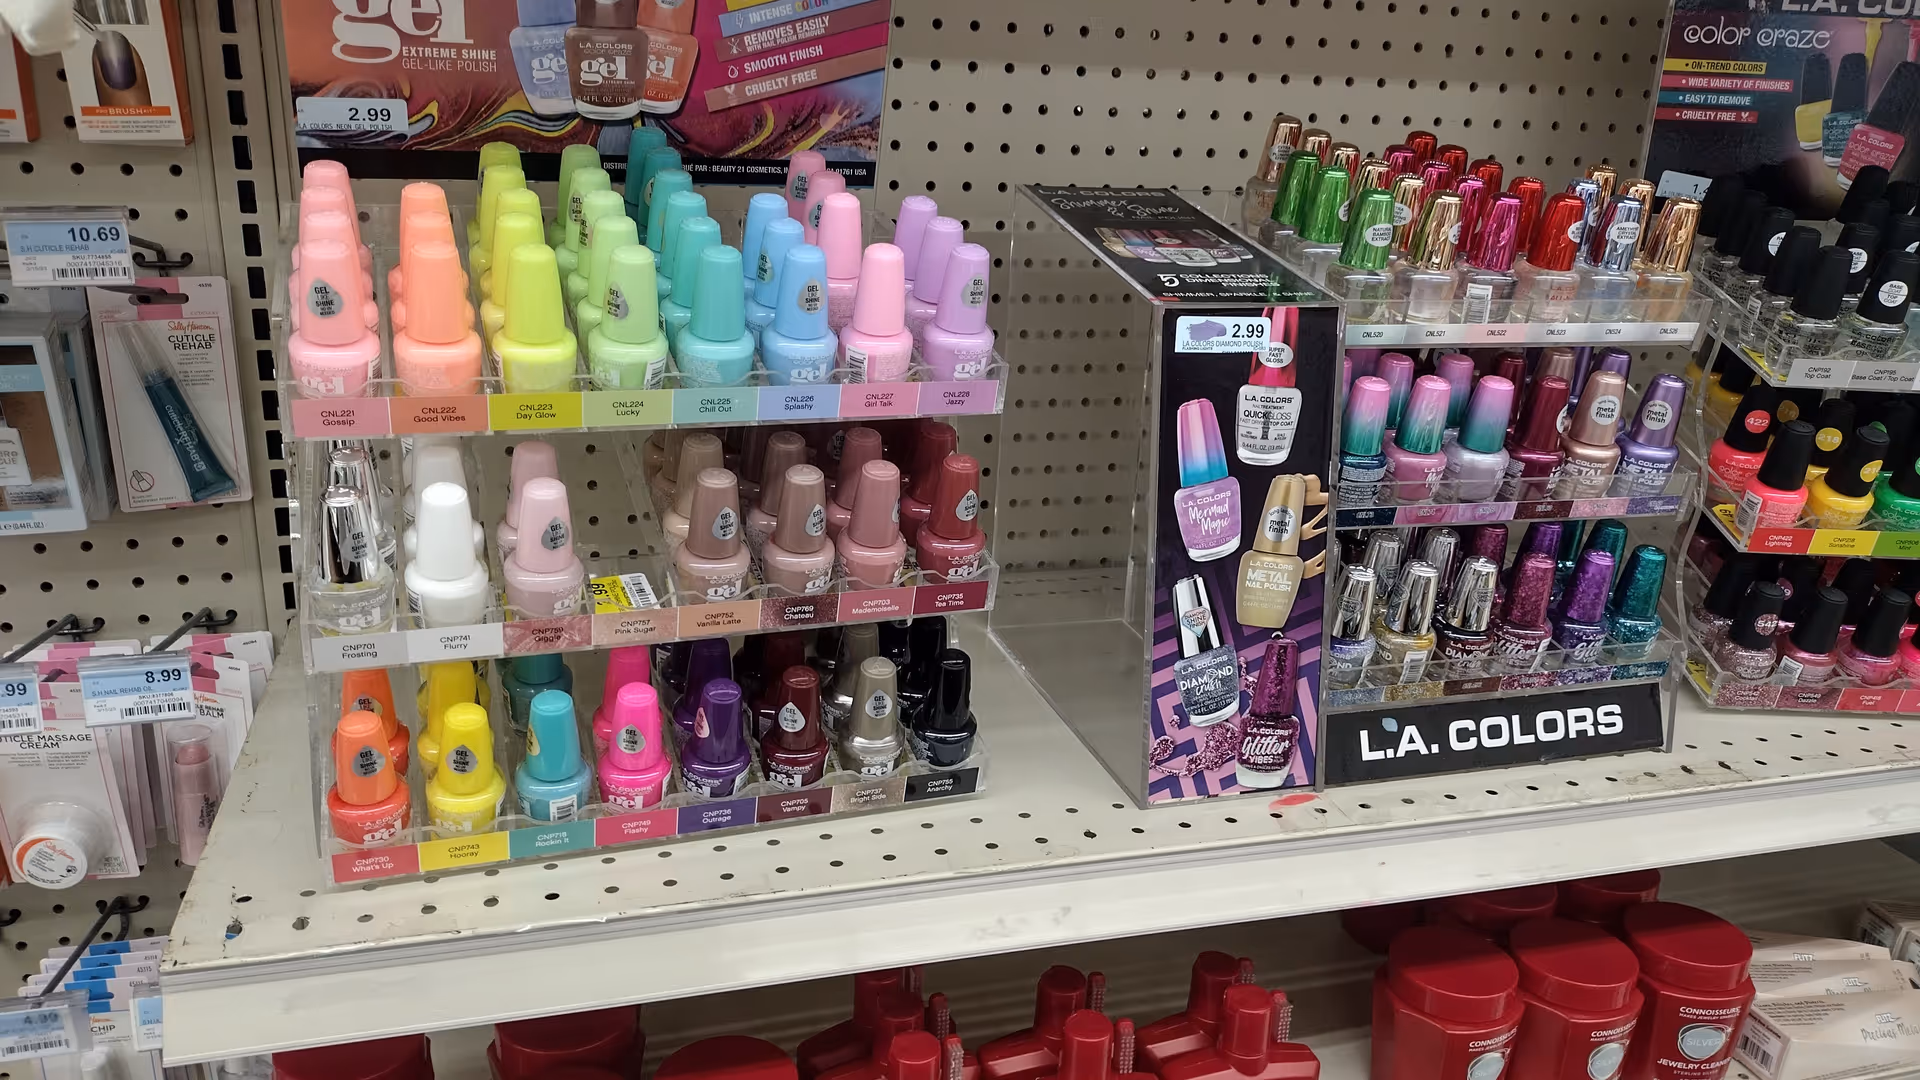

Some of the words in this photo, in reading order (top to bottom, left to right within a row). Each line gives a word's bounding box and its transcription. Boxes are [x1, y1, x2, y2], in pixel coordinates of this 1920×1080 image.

[749, 4, 793, 24] INTENSE
[744, 25, 793, 46] REMOVES
[796, 16, 830, 33] EASILY
[1684, 15, 1750, 46] color
[1756, 28, 1831, 49] craze
[746, 43, 761, 52] WITH
[762, 39, 776, 49] NAIL
[777, 34, 797, 45] POLISH
[798, 28, 825, 40] REMOVER
[402, 46, 457, 59] EXTREME
[462, 49, 497, 60] SHINE
[744, 54, 787, 74] SMOOTH
[790, 44, 823, 62] FINISH
[402, 59, 453, 71] GEL-LIKE
[457, 61, 497, 73] POLISH
[580, 55, 628, 86] gel
[1691, 61, 1731, 72] ON-TREND
[1733, 63, 1763, 73] COLORS
[745, 76, 789, 97] CRUELTY
[792, 69, 817, 85] FREE
[1688, 78, 1709, 87] WIDE
[1710, 79, 1742, 89] VARIETY
[1743, 80, 1754, 89] OF
[1755, 80, 1790, 91] FINISHES
[1685, 94, 1706, 103] EASY
[1707, 95, 1717, 104] TO
[1718, 95, 1750, 105] REMOVE
[108, 107, 143, 115] BRUSH
[348, 107, 391, 122] 2.99
[1682, 111, 1715, 120] CRUELTY
[1716, 112, 1736, 121] FREE
[1868, 137, 1894, 150] COLORS
[712, 165, 736, 173] BEAUTY
[747, 166, 782, 174] COSMETICS,
[1079, 189, 1166, 197] COLORS
[67, 226, 120, 242] 10.69
[35, 244, 64, 252] CUTICLE
[65, 244, 90, 252] REHAB
[973, 278, 984, 286] GEL
[1157, 273, 1180, 287] 5
[314, 286, 330, 294] GEL
[807, 285, 819, 293] GEL
[168, 321, 188, 333] Sally
[1232, 324, 1264, 338] 2.99
[168, 334, 216, 344] CUTICLE
[173, 341, 213, 351] REHAB
[700, 398, 731, 406] CNL225
[784, 395, 814, 403] CNL226
[864, 400, 876, 408] Girl
[877, 399, 893, 407] Talk
[946, 398, 965, 406] Jazzy
[1244, 394, 1259, 402] L.A.
[1260, 396, 1293, 404] COLORS
[421, 406, 457, 414] CNL222
[519, 403, 553, 411] CNL223
[784, 402, 813, 411] Splashy
[516, 411, 533, 420] Day
[534, 410, 557, 419] Glow
[616, 408, 640, 417] Lucky
[1595, 411, 1615, 419] finish
[322, 418, 355, 427] Gossip
[413, 415, 435, 423] Good
[439, 414, 466, 422] Vibes
[1645, 414, 1666, 424] finish
[1746, 417, 1769, 426] 422
[1197, 491, 1231, 504] COLORS
[1188, 498, 1229, 524] Mermaid
[1269, 519, 1290, 527] metal
[1268, 525, 1289, 534] finish
[1765, 540, 1792, 548] Lightning
[1263, 562, 1293, 570] COLORS
[1246, 569, 1292, 585] METAL
[1245, 581, 1262, 589] NAIL
[1264, 582, 1291, 592] POLISH
[862, 599, 891, 607] CNP703
[852, 605, 899, 615] Mademoiselle
[705, 612, 734, 620] CNP752
[784, 612, 814, 620] Chateau
[696, 620, 720, 628] Vanilla
[722, 618, 741, 626] Latte
[1757, 620, 1777, 628] 542
[615, 626, 631, 634] Pink
[632, 625, 656, 634] Sugar
[439, 634, 471, 643] CNP741
[342, 643, 375, 652] CNP701
[443, 641, 468, 650] Flurry
[342, 650, 377, 659] Frosting
[1196, 655, 1229, 670] COLORS
[145, 668, 182, 684] 8.99
[200, 711, 224, 719] BALM
[1359, 724, 1440, 762] L.A.
[1449, 703, 1623, 752] COLORS
[37, 733, 92, 742] MASSAGE
[19, 741, 61, 749] CREAM
[1242, 735, 1290, 759] Glitter
[1249, 755, 1273, 763] VIBES
[855, 788, 882, 797] CNP737
[926, 784, 953, 794] Anarchy
[850, 795, 869, 804] Bright
[870, 793, 886, 801] Side
[702, 808, 732, 817] CNP736
[782, 804, 806, 813] Vampy
[702, 815, 732, 824] Outrage
[624, 826, 648, 835] Flashy
[535, 839, 561, 847] Rockin
[448, 844, 480, 853] CNP743
[450, 850, 479, 859] Hooray
[356, 856, 389, 865] CNP730
[352, 863, 380, 873] What's
[382, 862, 394, 871] Up
[1843, 978, 1861, 987] FLITZ
[1680, 1006, 1741, 1016] CONNOISSEURS
[1876, 1014, 1893, 1024] FLITZ
[90, 1024, 116, 1033] CHIP
[1860, 1026, 1898, 1043] Precious
[1685, 1037, 1721, 1048] SILVER
[1657, 1058, 1699, 1070] JEWELRY
